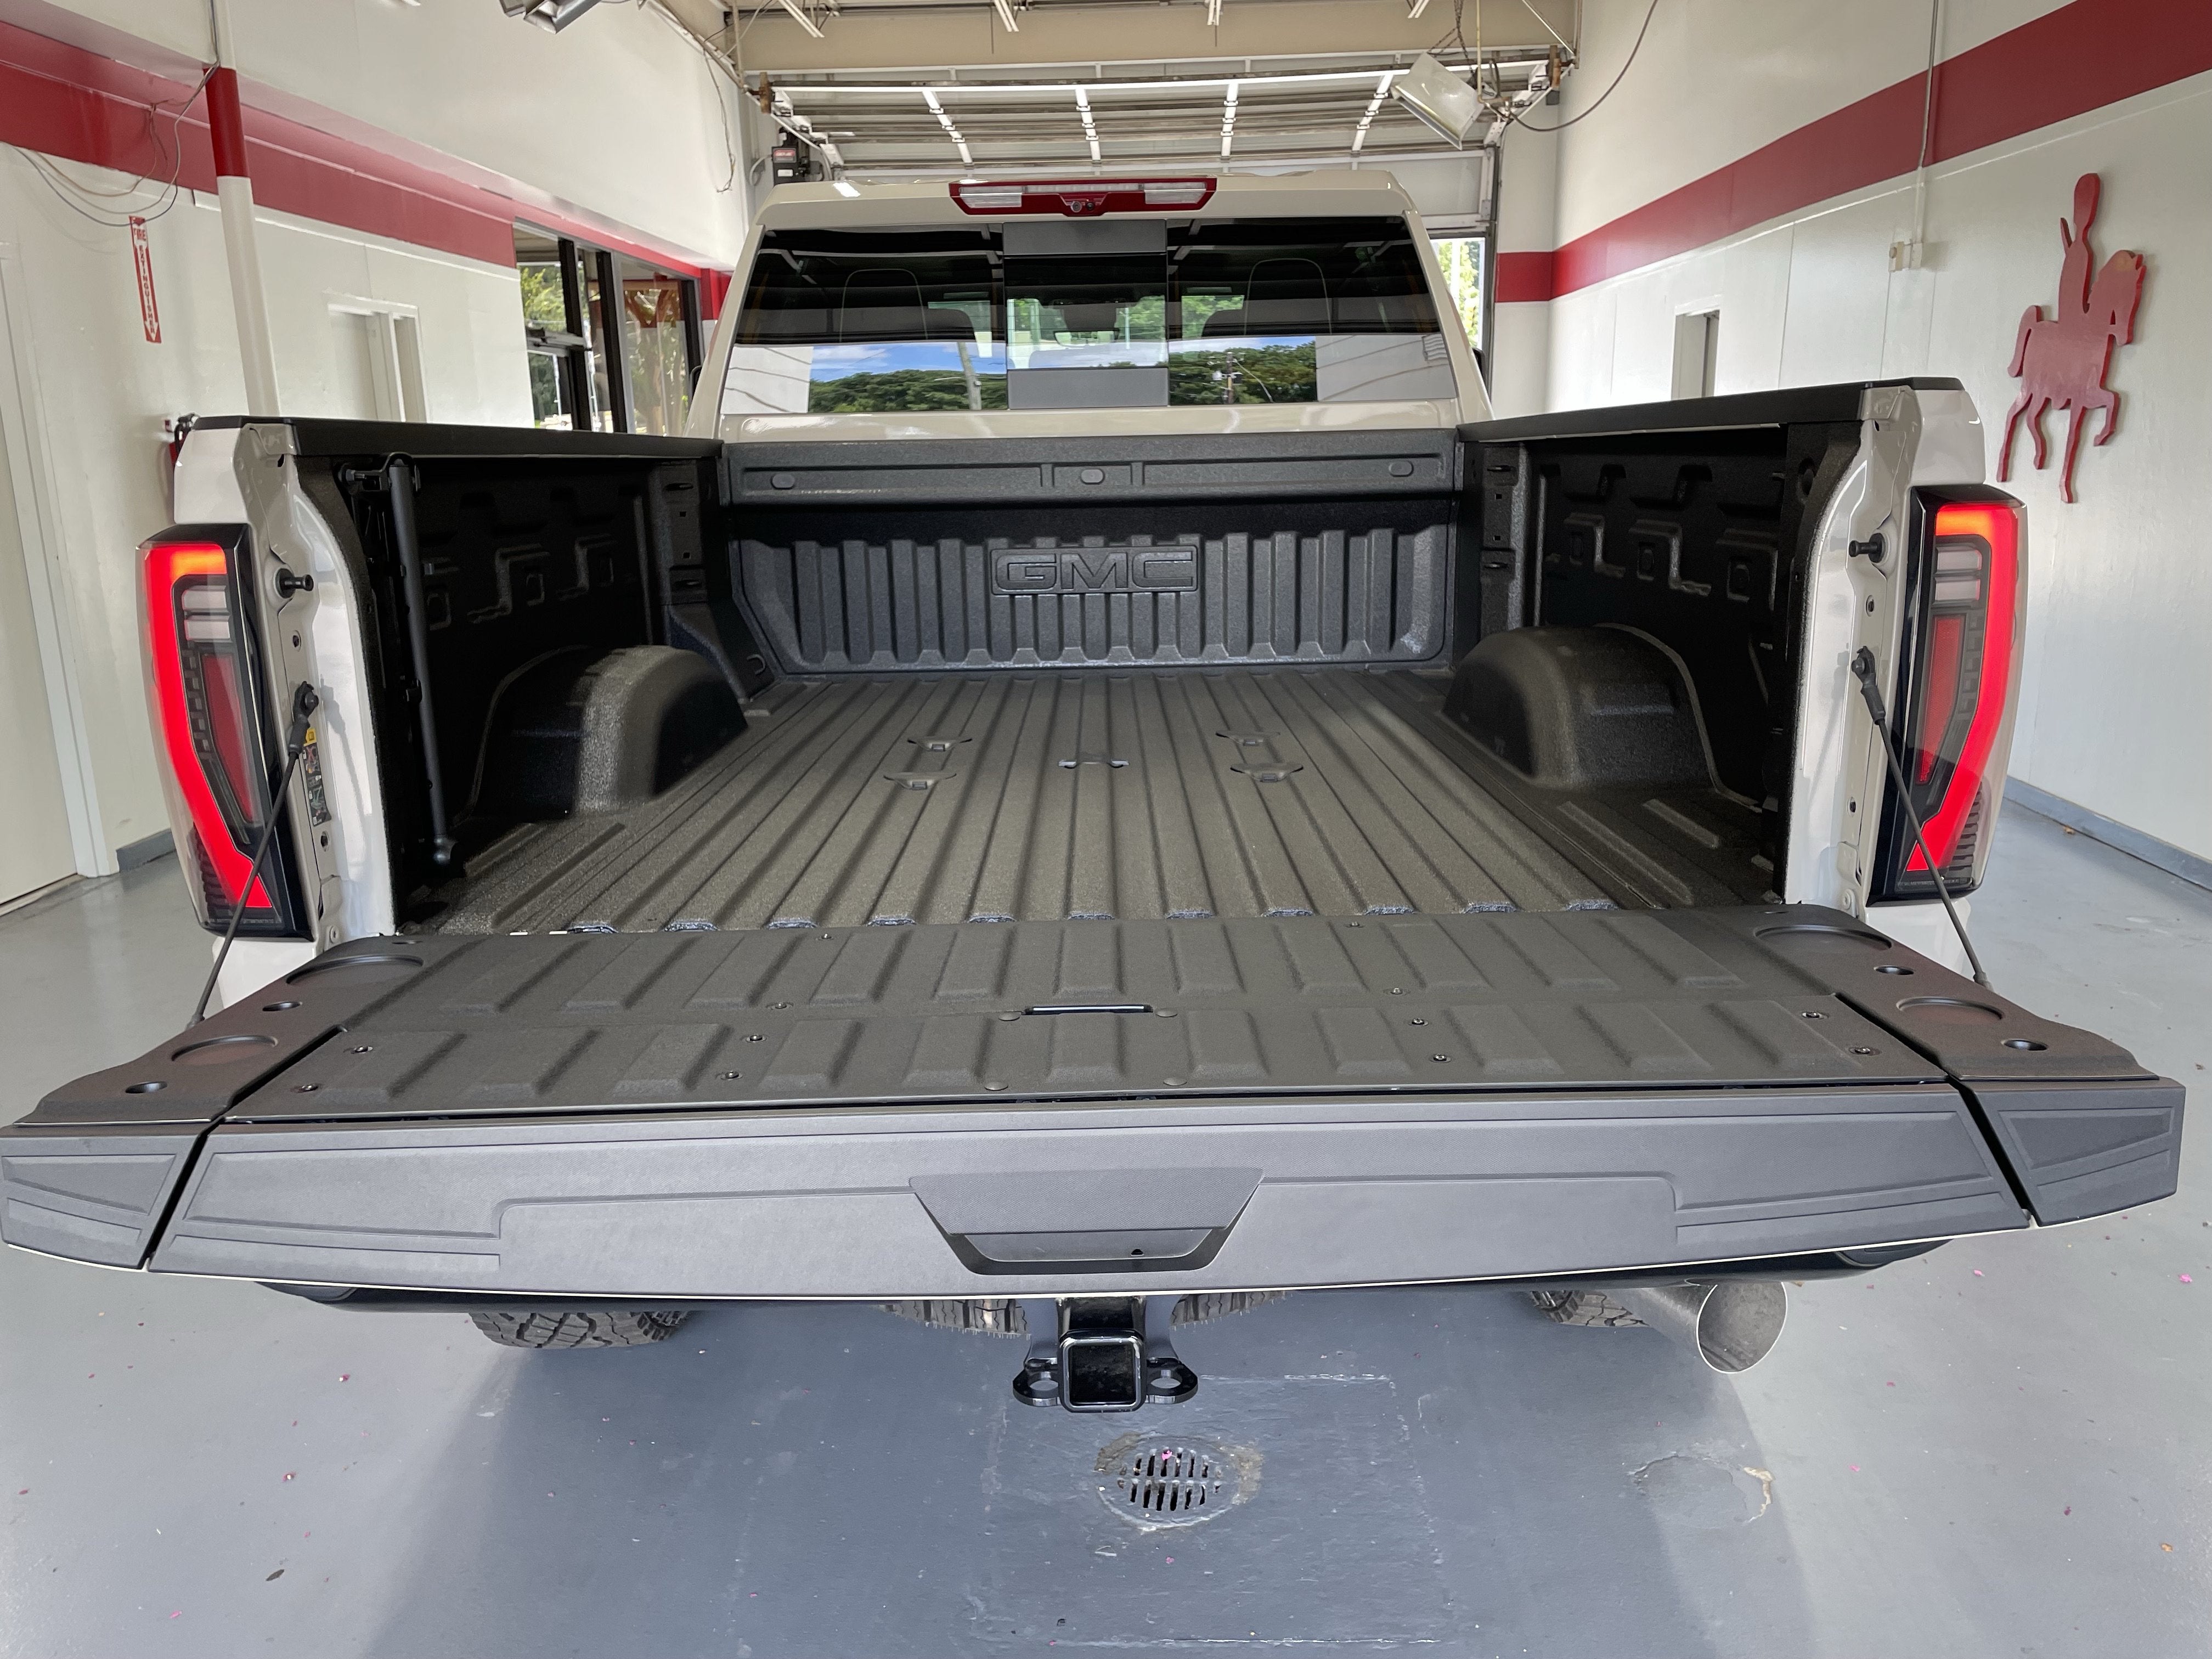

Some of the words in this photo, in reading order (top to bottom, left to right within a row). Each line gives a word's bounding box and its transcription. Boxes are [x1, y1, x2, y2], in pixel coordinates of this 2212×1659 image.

[133, 228, 146, 241] FIRE
[139, 245, 155, 334] EXTINGUISHER
[995, 551, 1194, 591] GMC
